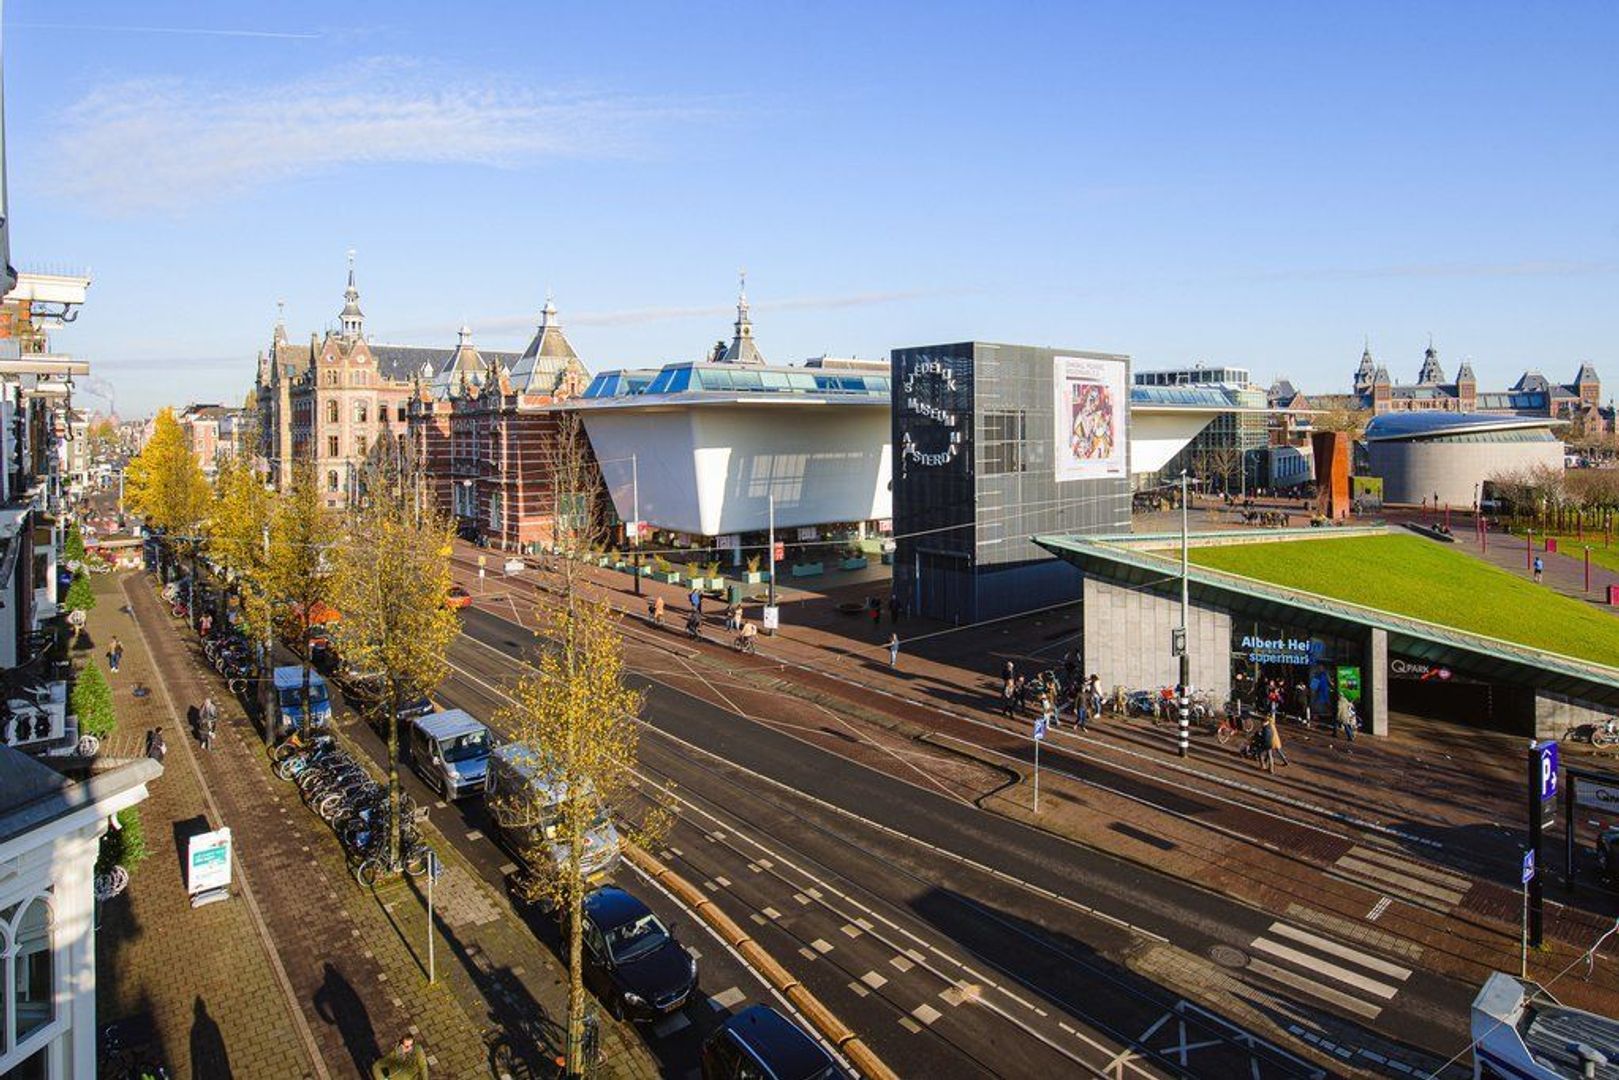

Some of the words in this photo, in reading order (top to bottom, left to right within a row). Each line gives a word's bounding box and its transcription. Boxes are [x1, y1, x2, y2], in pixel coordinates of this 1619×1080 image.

[907, 398, 956, 427] MUSEUM
[1241, 636, 1284, 650] Albert
[1541, 758, 1552, 795] P
